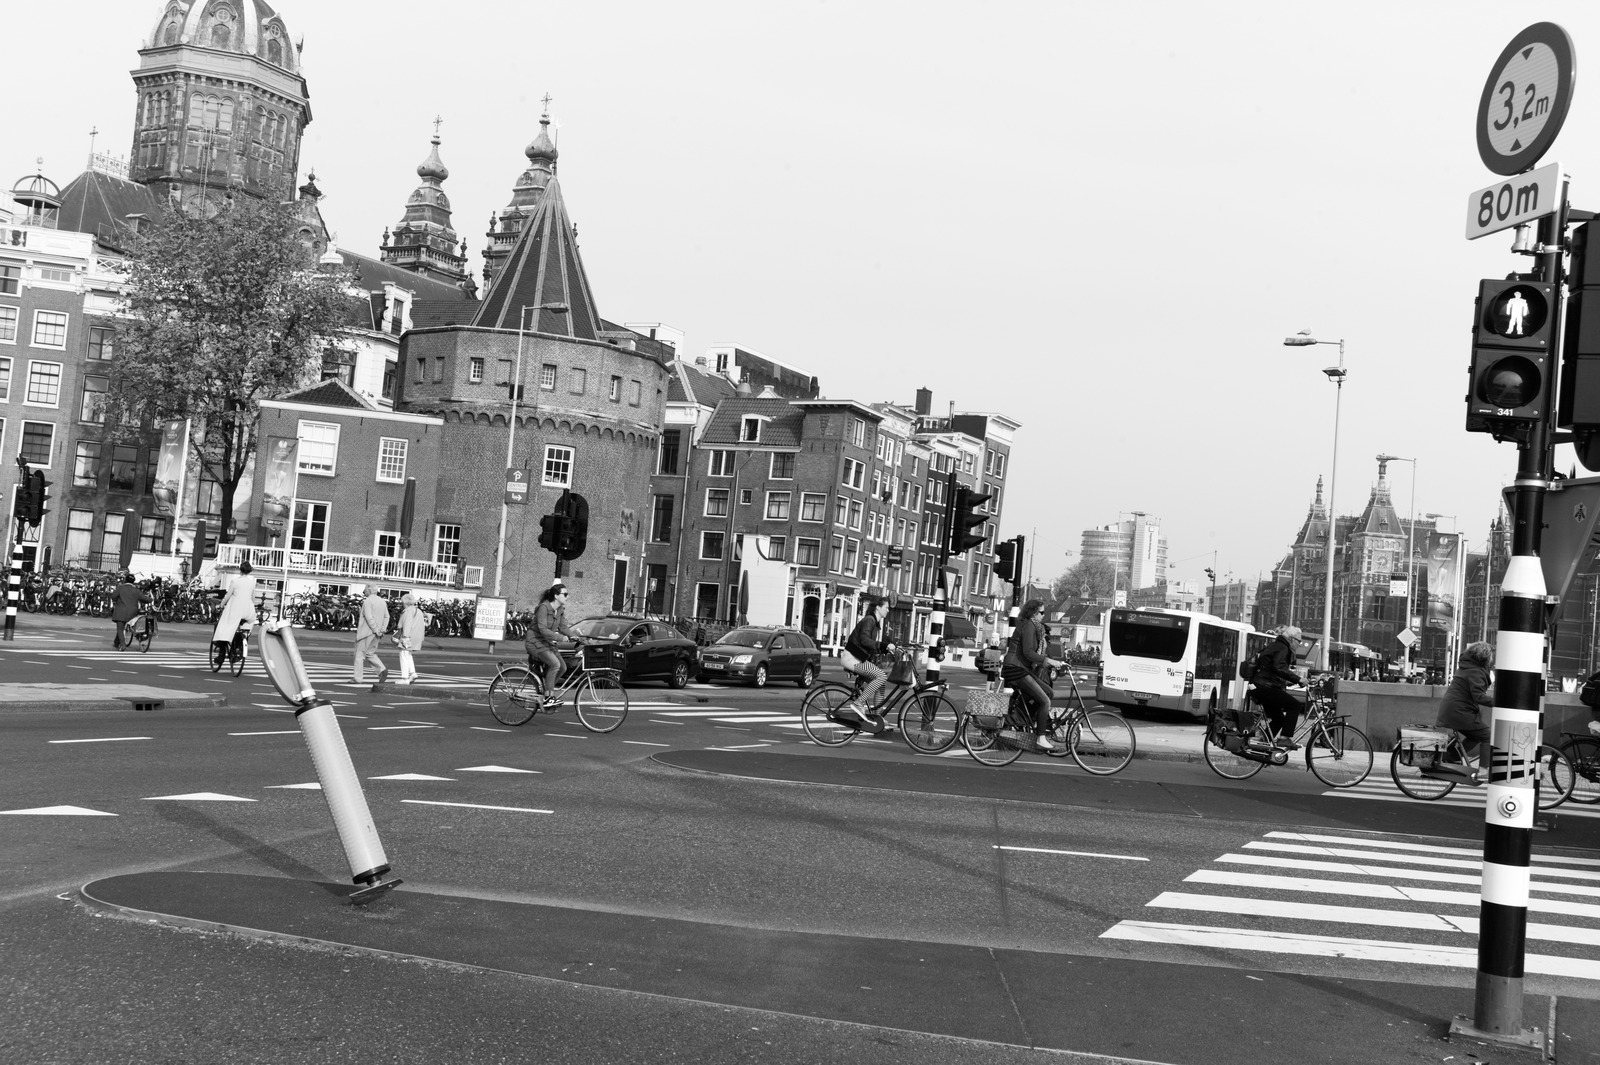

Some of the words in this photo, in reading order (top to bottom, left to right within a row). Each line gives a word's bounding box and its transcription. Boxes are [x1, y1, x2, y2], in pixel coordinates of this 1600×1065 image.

[1493, 80, 1550, 131] 3,2m
[1477, 182, 1540, 228] 80m
[1497, 408, 1513, 416] 341
[993, 598, 1005, 611] M
[478, 608, 501, 617] KEULEN
[1128, 613, 1137, 621] 32
[481, 616, 503, 625] PARIJS
